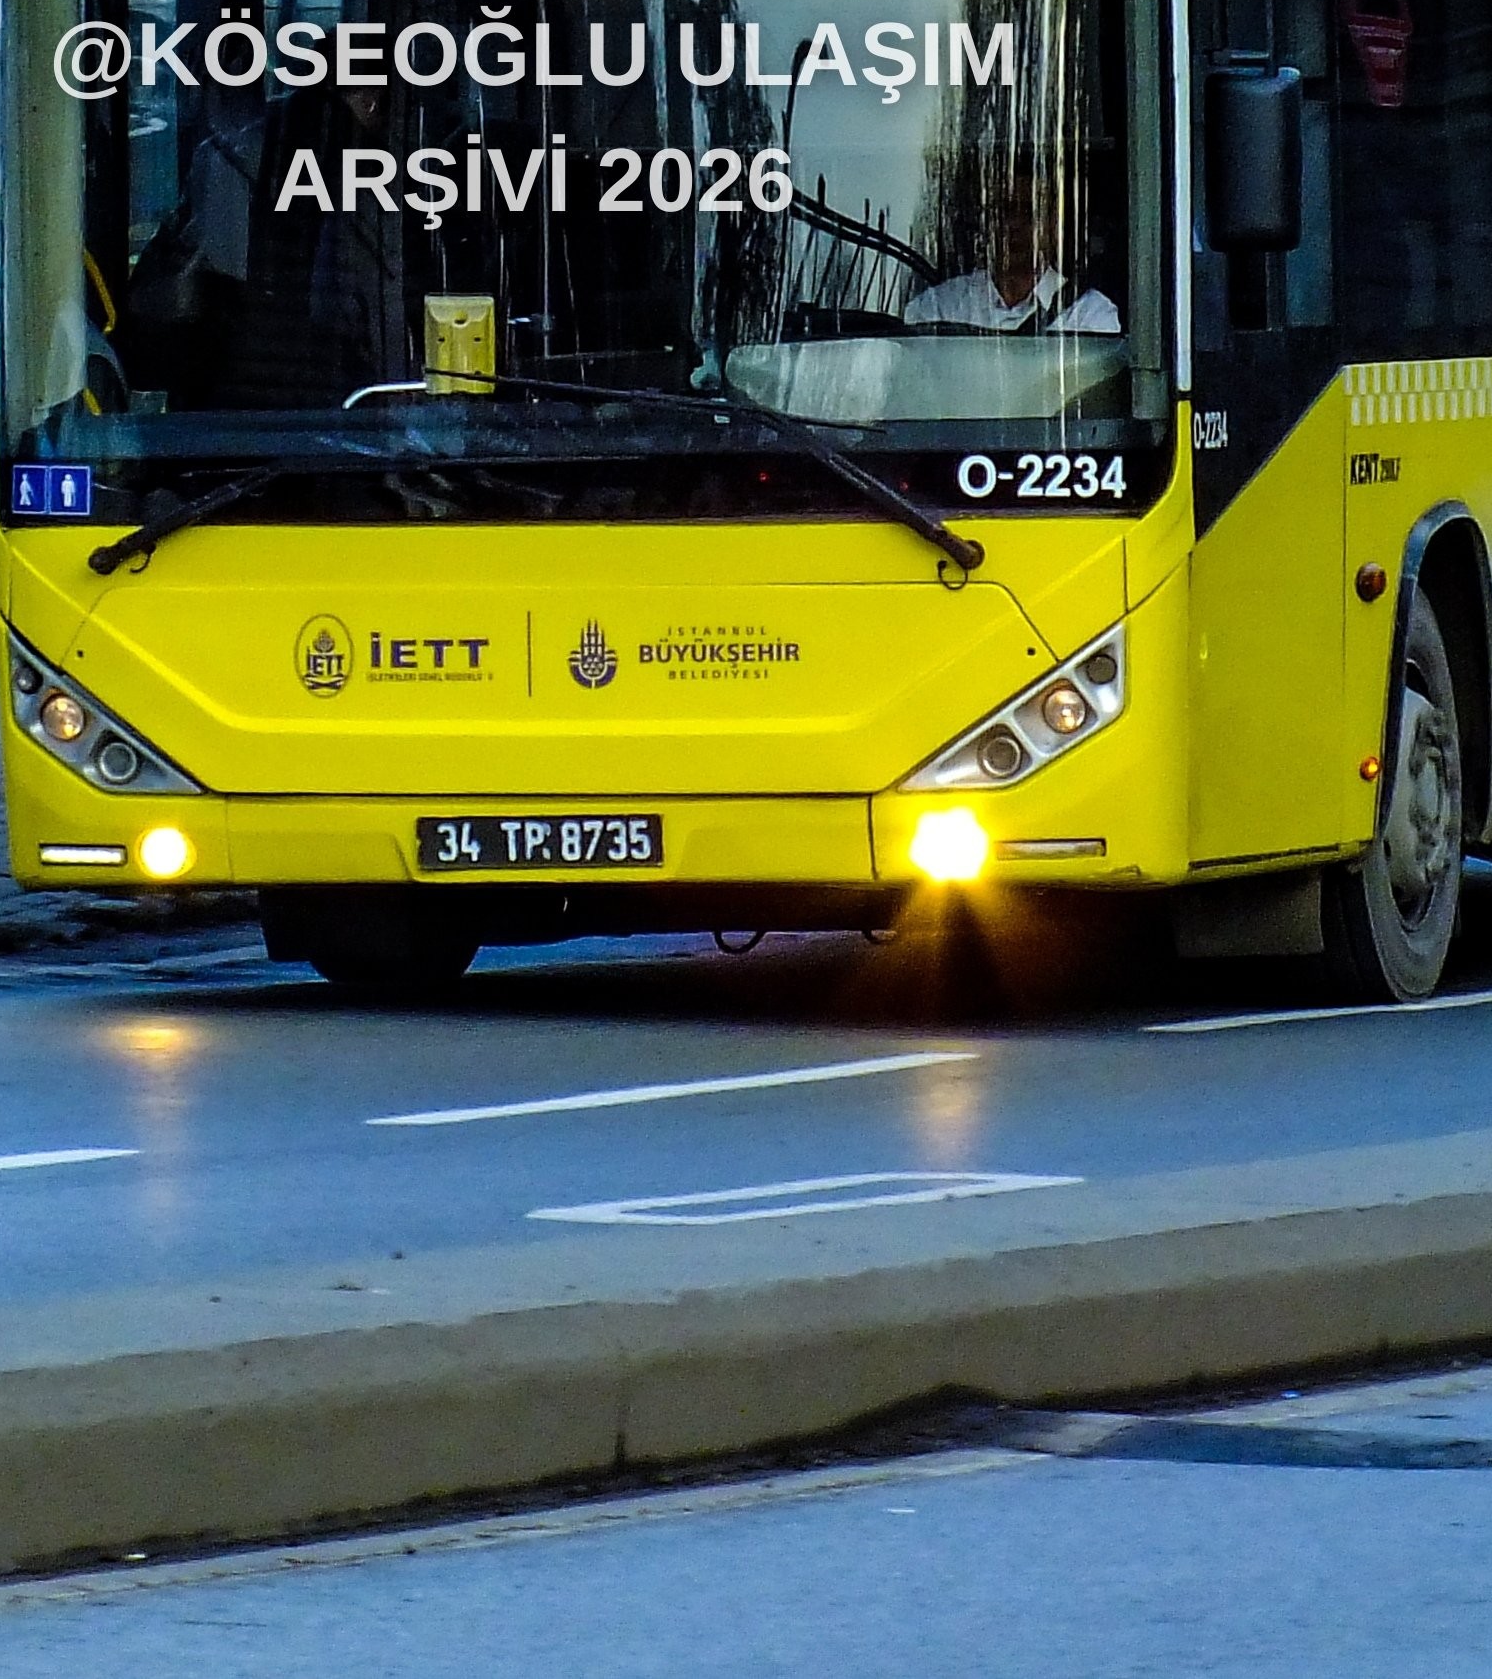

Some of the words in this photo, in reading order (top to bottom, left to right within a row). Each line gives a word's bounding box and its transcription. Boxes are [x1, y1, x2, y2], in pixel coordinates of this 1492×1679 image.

[958, 454, 1127, 499] O-2234
[370, 632, 489, 668] İETT
[639, 638, 801, 668] BÜYÜKŞEHİR
[437, 823, 481, 862] 34
[561, 820, 651, 861] 8735
